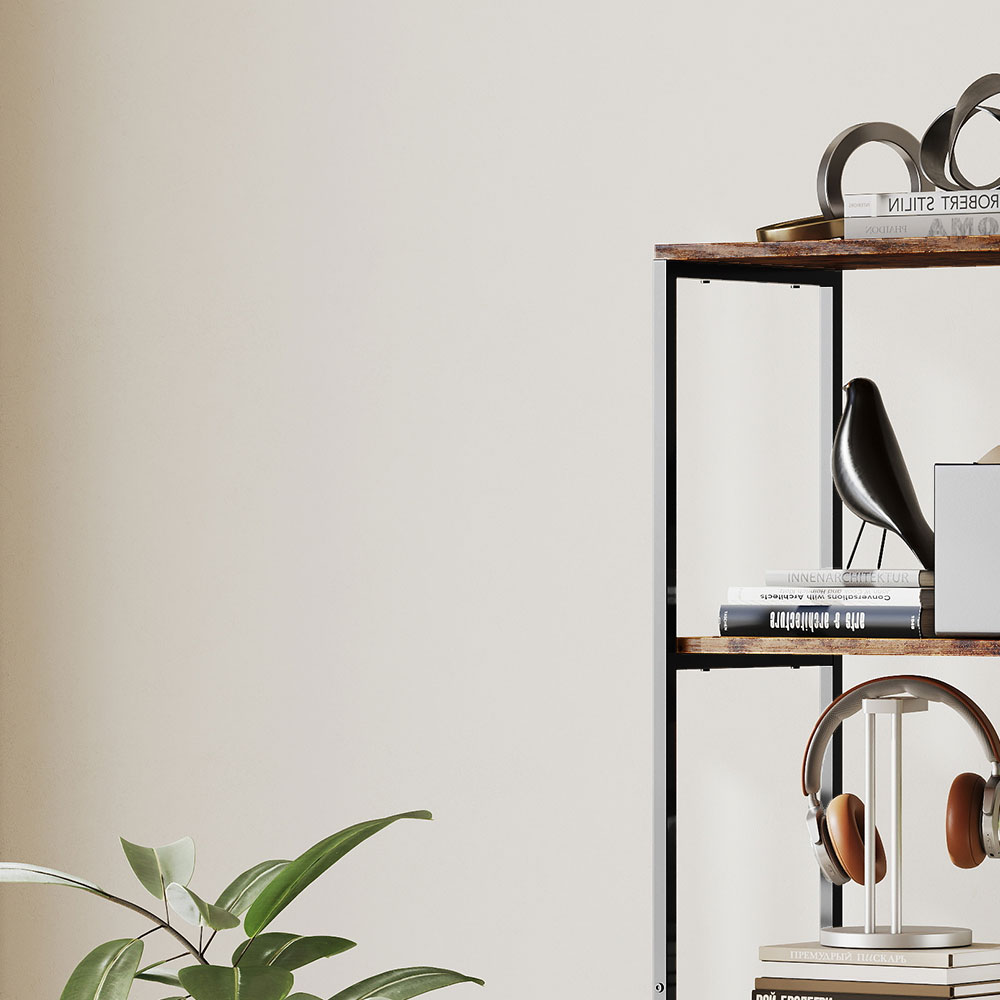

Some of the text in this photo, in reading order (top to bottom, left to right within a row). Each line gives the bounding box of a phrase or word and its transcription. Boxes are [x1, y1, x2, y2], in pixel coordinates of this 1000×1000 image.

[787, 572, 909, 583] INNENARCHITEKTUR
[770, 612, 830, 632] architecture
[845, 612, 865, 632] arts
